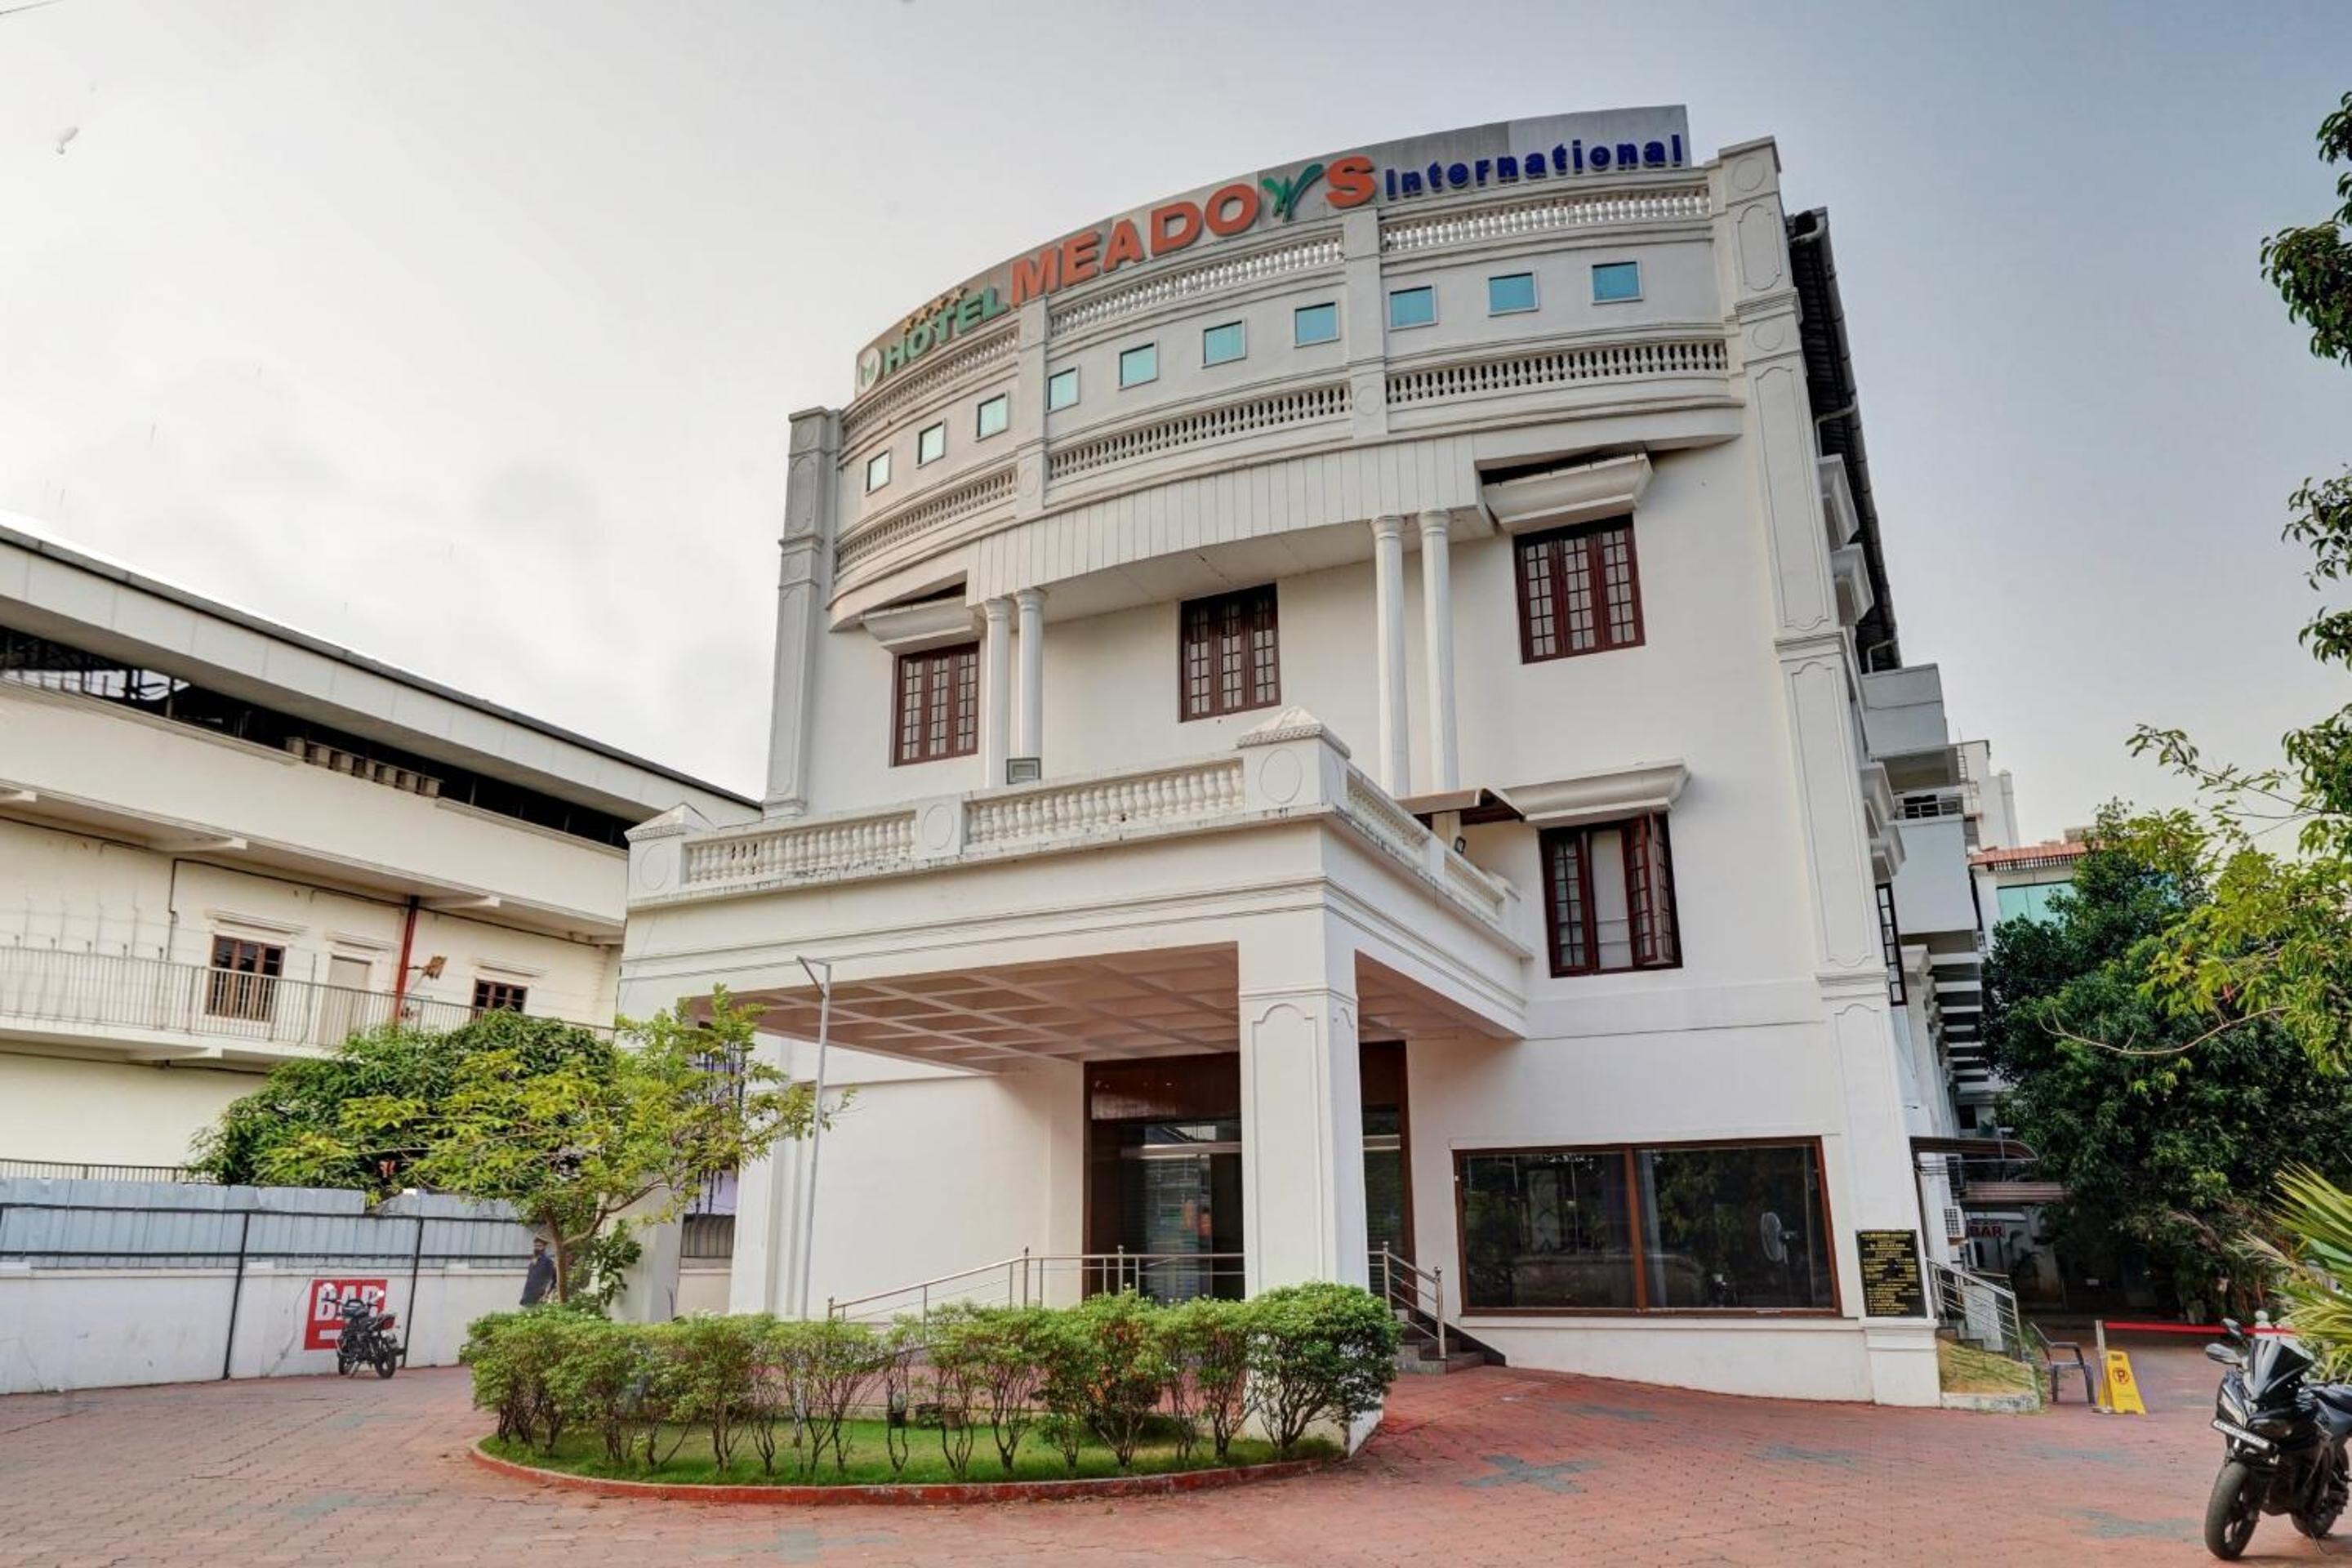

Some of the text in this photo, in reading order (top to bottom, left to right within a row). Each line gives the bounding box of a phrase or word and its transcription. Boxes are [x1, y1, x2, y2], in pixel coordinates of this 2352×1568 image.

[883, 134, 1682, 376] HOTEL MEADOWS International
[1969, 1225, 2003, 1237] BAR
[314, 1284, 381, 1321] BAR
